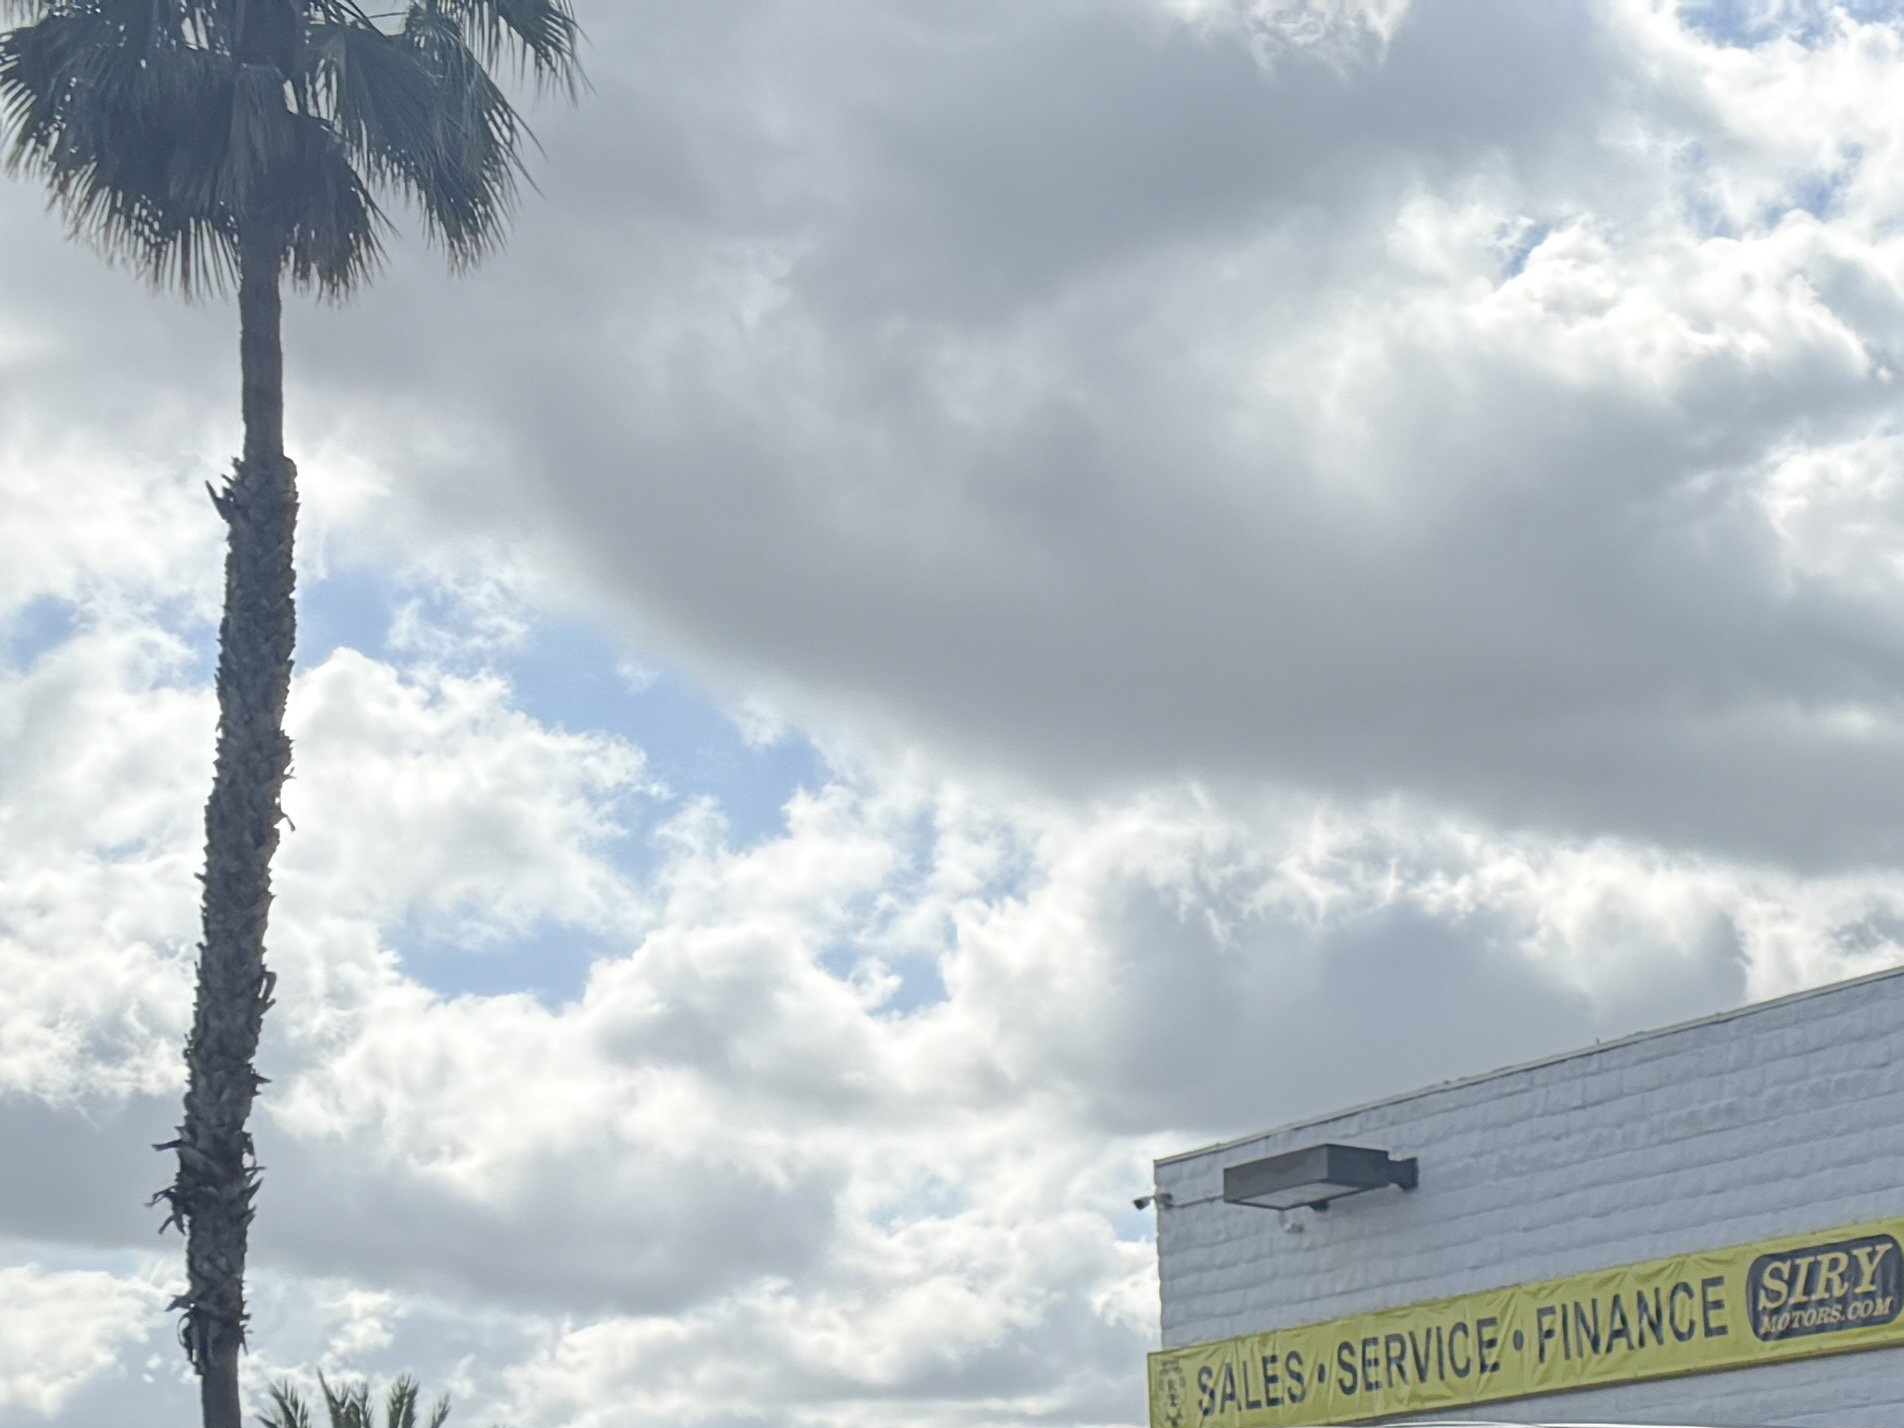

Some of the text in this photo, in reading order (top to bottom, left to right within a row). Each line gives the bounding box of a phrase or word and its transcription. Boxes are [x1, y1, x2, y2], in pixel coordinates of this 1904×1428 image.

[1759, 1243, 1893, 1311] SIRY
[1196, 1275, 1728, 1417] SALES SERVICE FINANCE
[1760, 1296, 1893, 1335] MOTORS.COM
